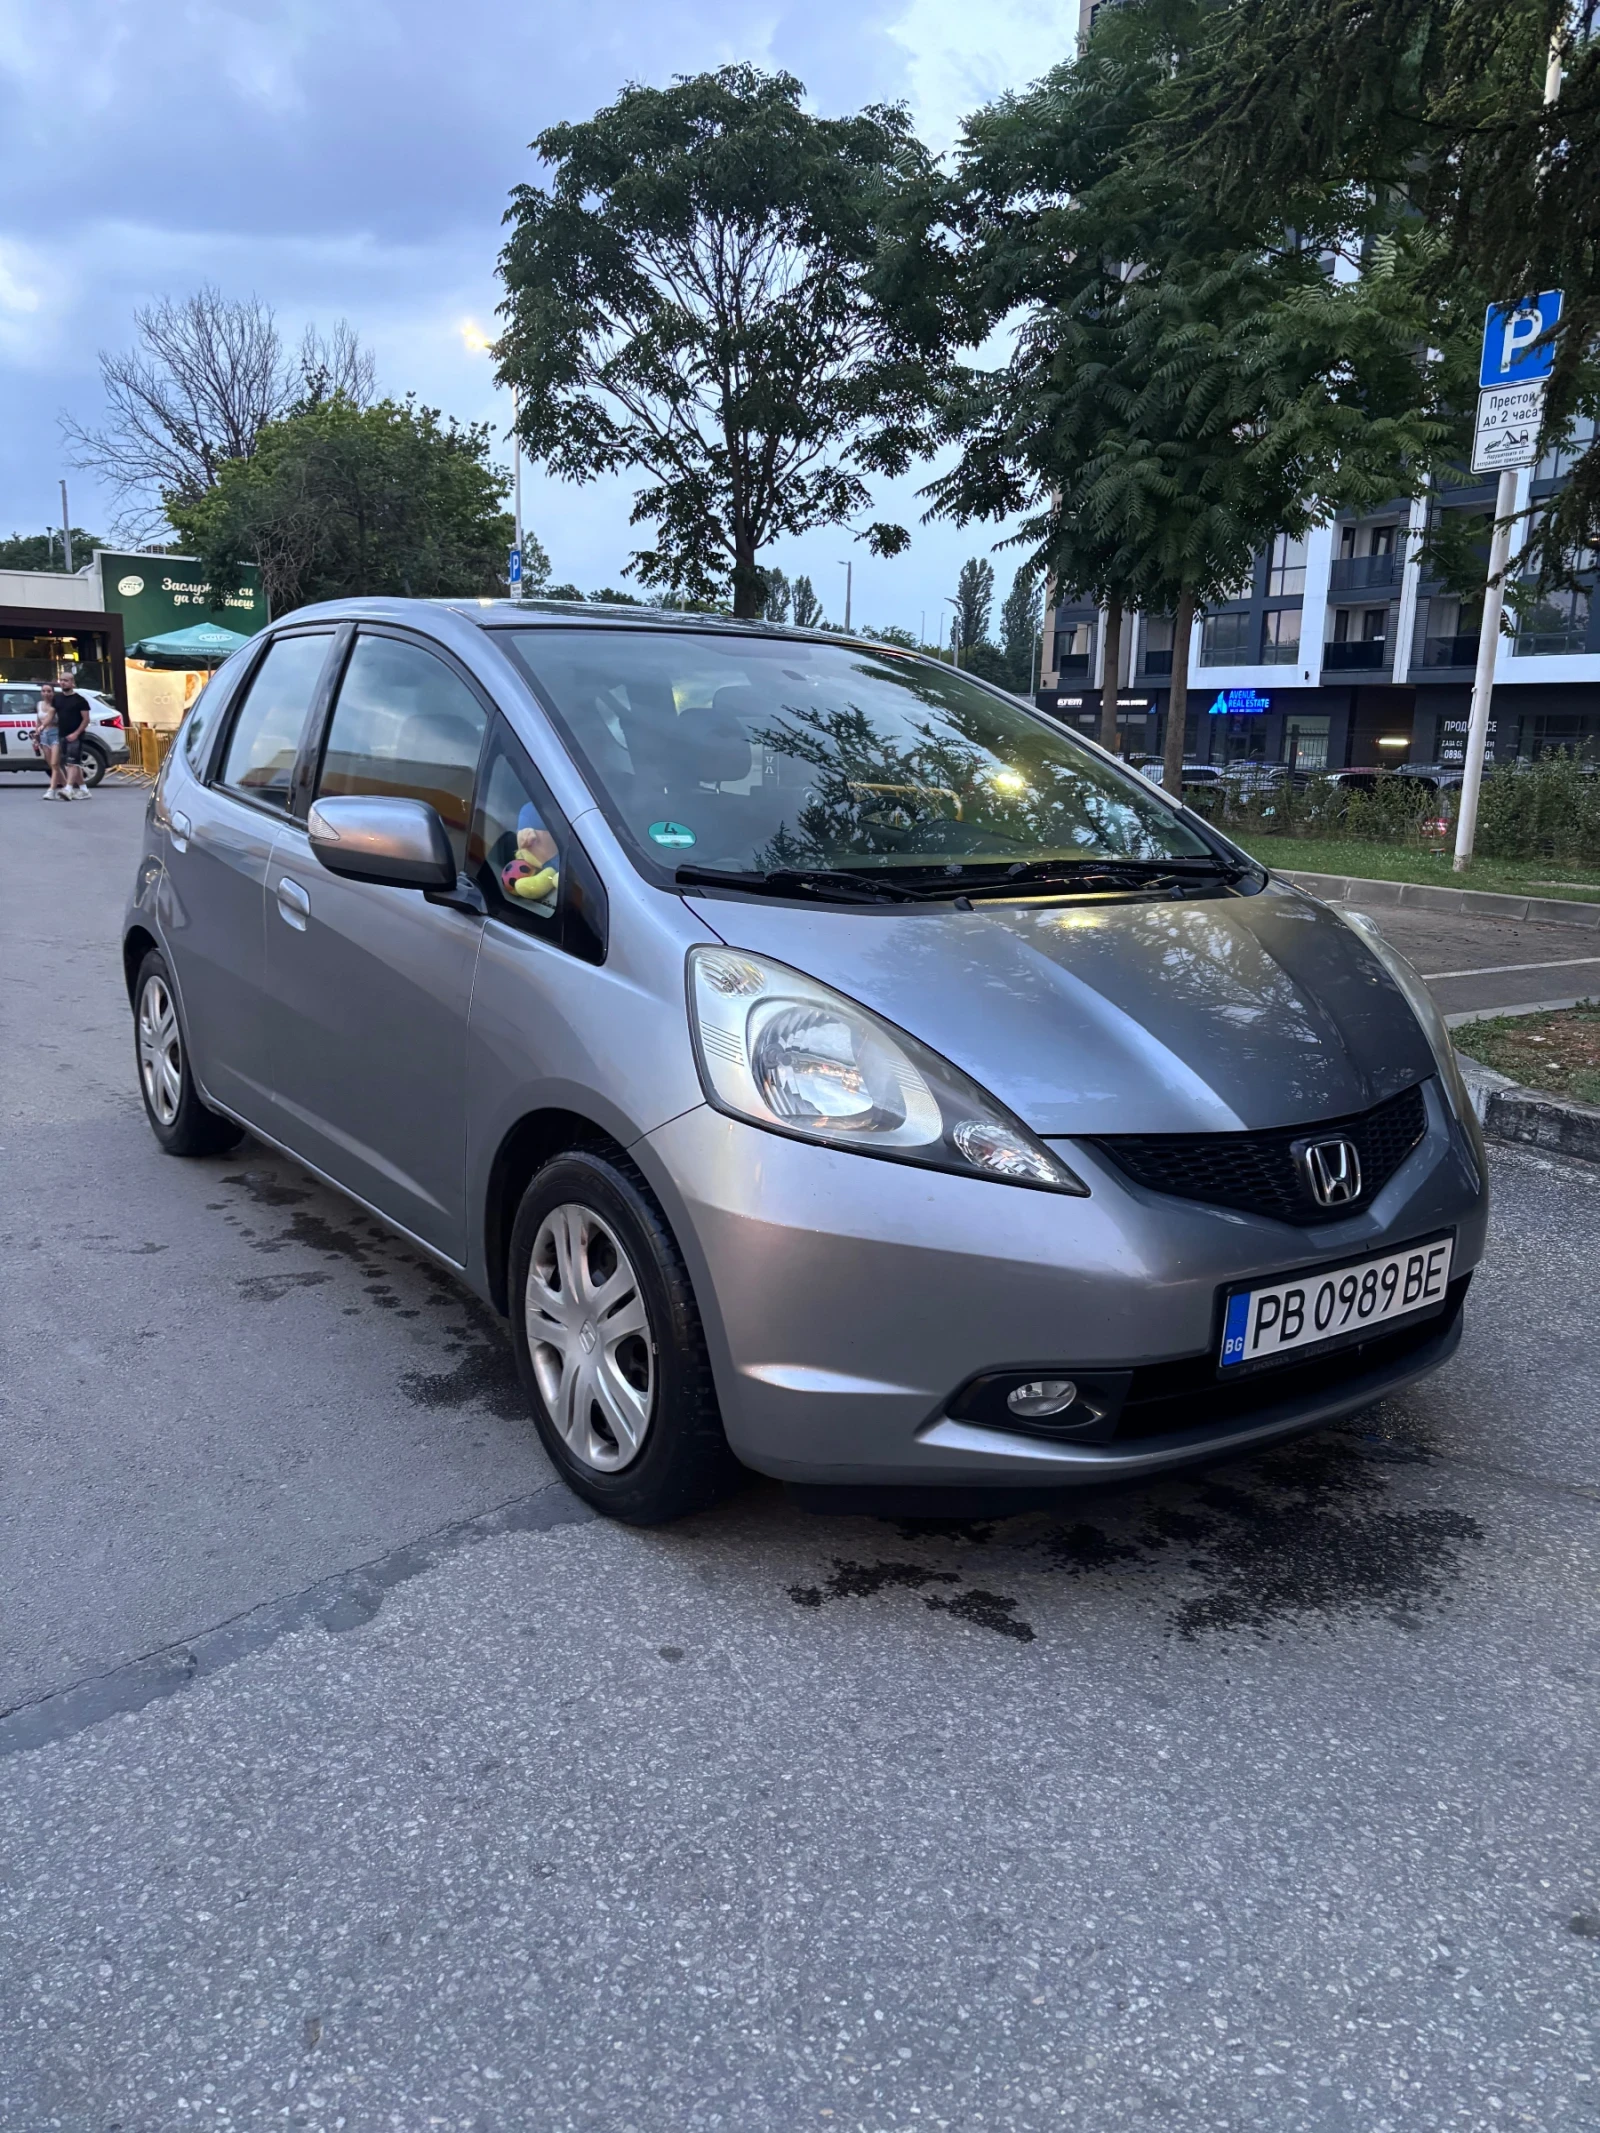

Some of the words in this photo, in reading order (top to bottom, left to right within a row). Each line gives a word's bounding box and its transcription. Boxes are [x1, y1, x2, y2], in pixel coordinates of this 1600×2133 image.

[1500, 308, 1543, 373] P
[1490, 391, 1536, 411] Престой
[1483, 415, 1497, 427] до
[1501, 410, 1509, 423] 2
[1513, 408, 1538, 420] часа
[513, 555, 519, 578] P
[238, 587, 254, 596] си
[173, 594, 190, 606] да
[192, 595, 205, 604] се
[1229, 690, 1256, 699] AVENUE
[1229, 699, 1245, 708] REAL
[1245, 699, 1270, 708] ESTATE
[1444, 721, 1467, 733] ПРОД
[664, 822, 678, 835] 4
[1252, 1288, 1306, 1350] PB
[1314, 1262, 1400, 1331] 0989
[1402, 1246, 1446, 1305] BE
[1225, 1336, 1243, 1354] BG
